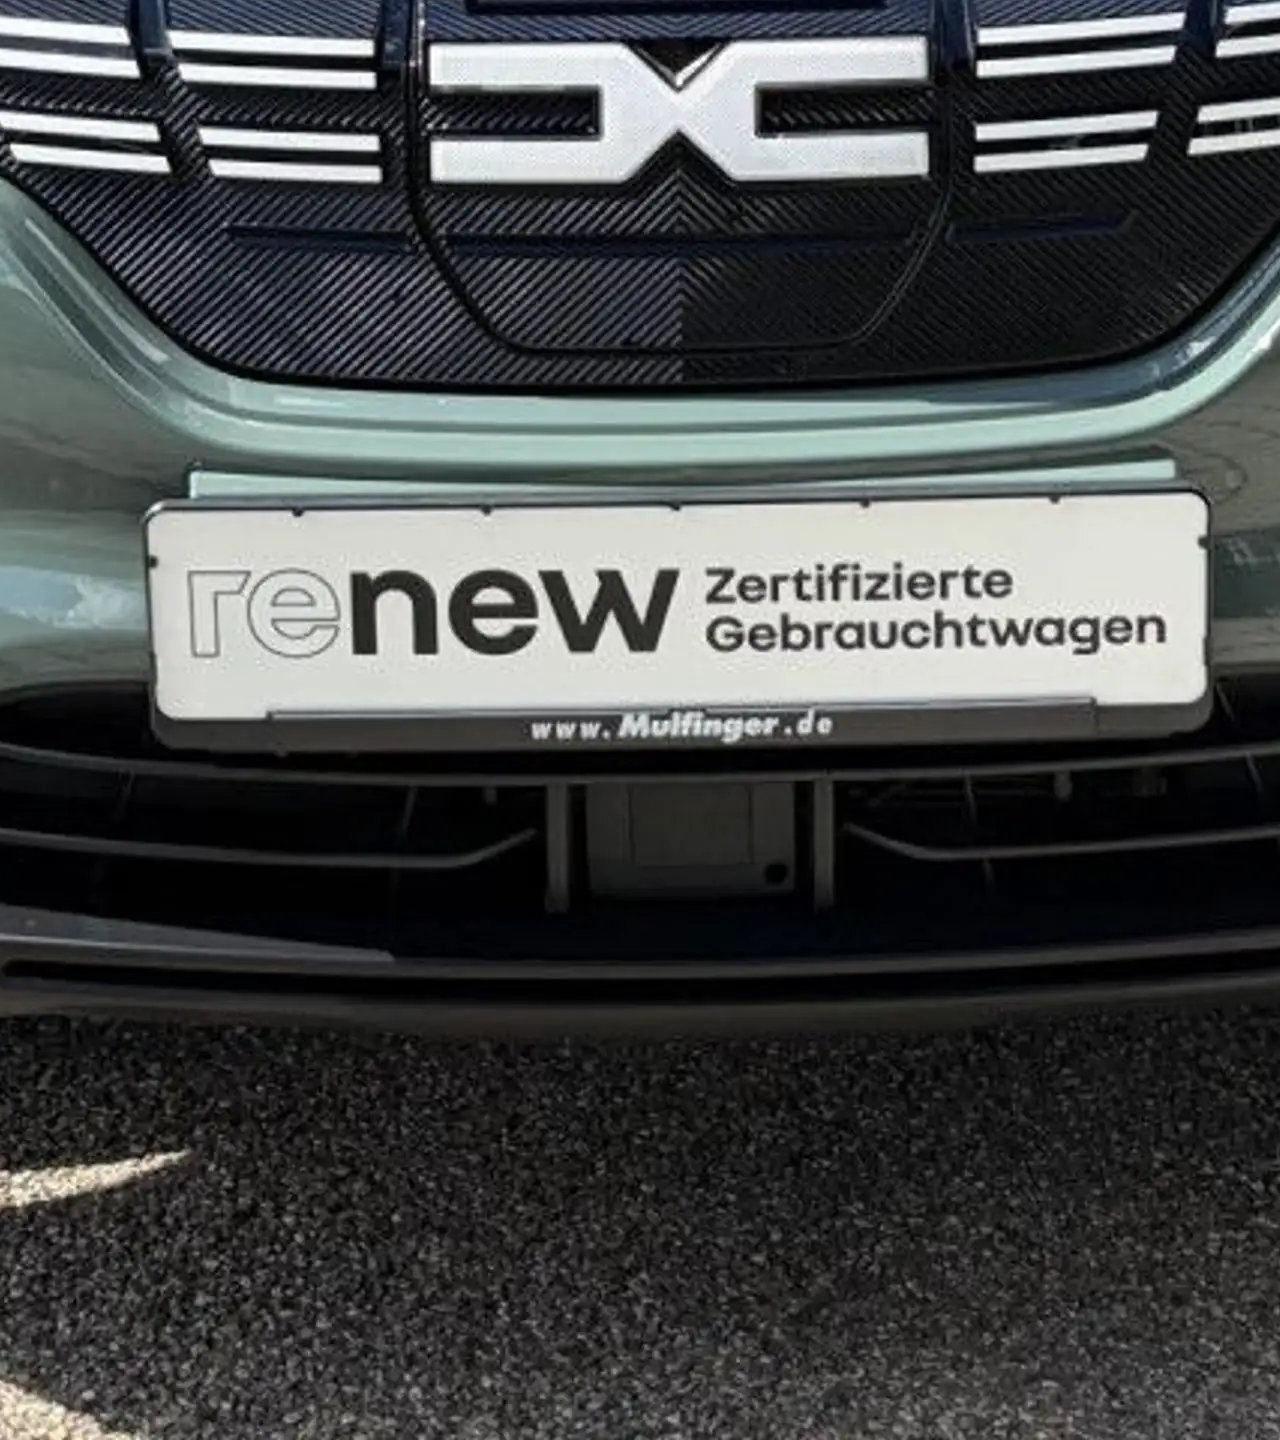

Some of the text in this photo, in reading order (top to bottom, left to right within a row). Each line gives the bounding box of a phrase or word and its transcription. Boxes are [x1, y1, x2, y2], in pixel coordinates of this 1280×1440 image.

[705, 562, 1014, 604] Zertifizierte
[187, 567, 680, 658] renew
[705, 610, 1168, 655] Gebrauchtwagen
